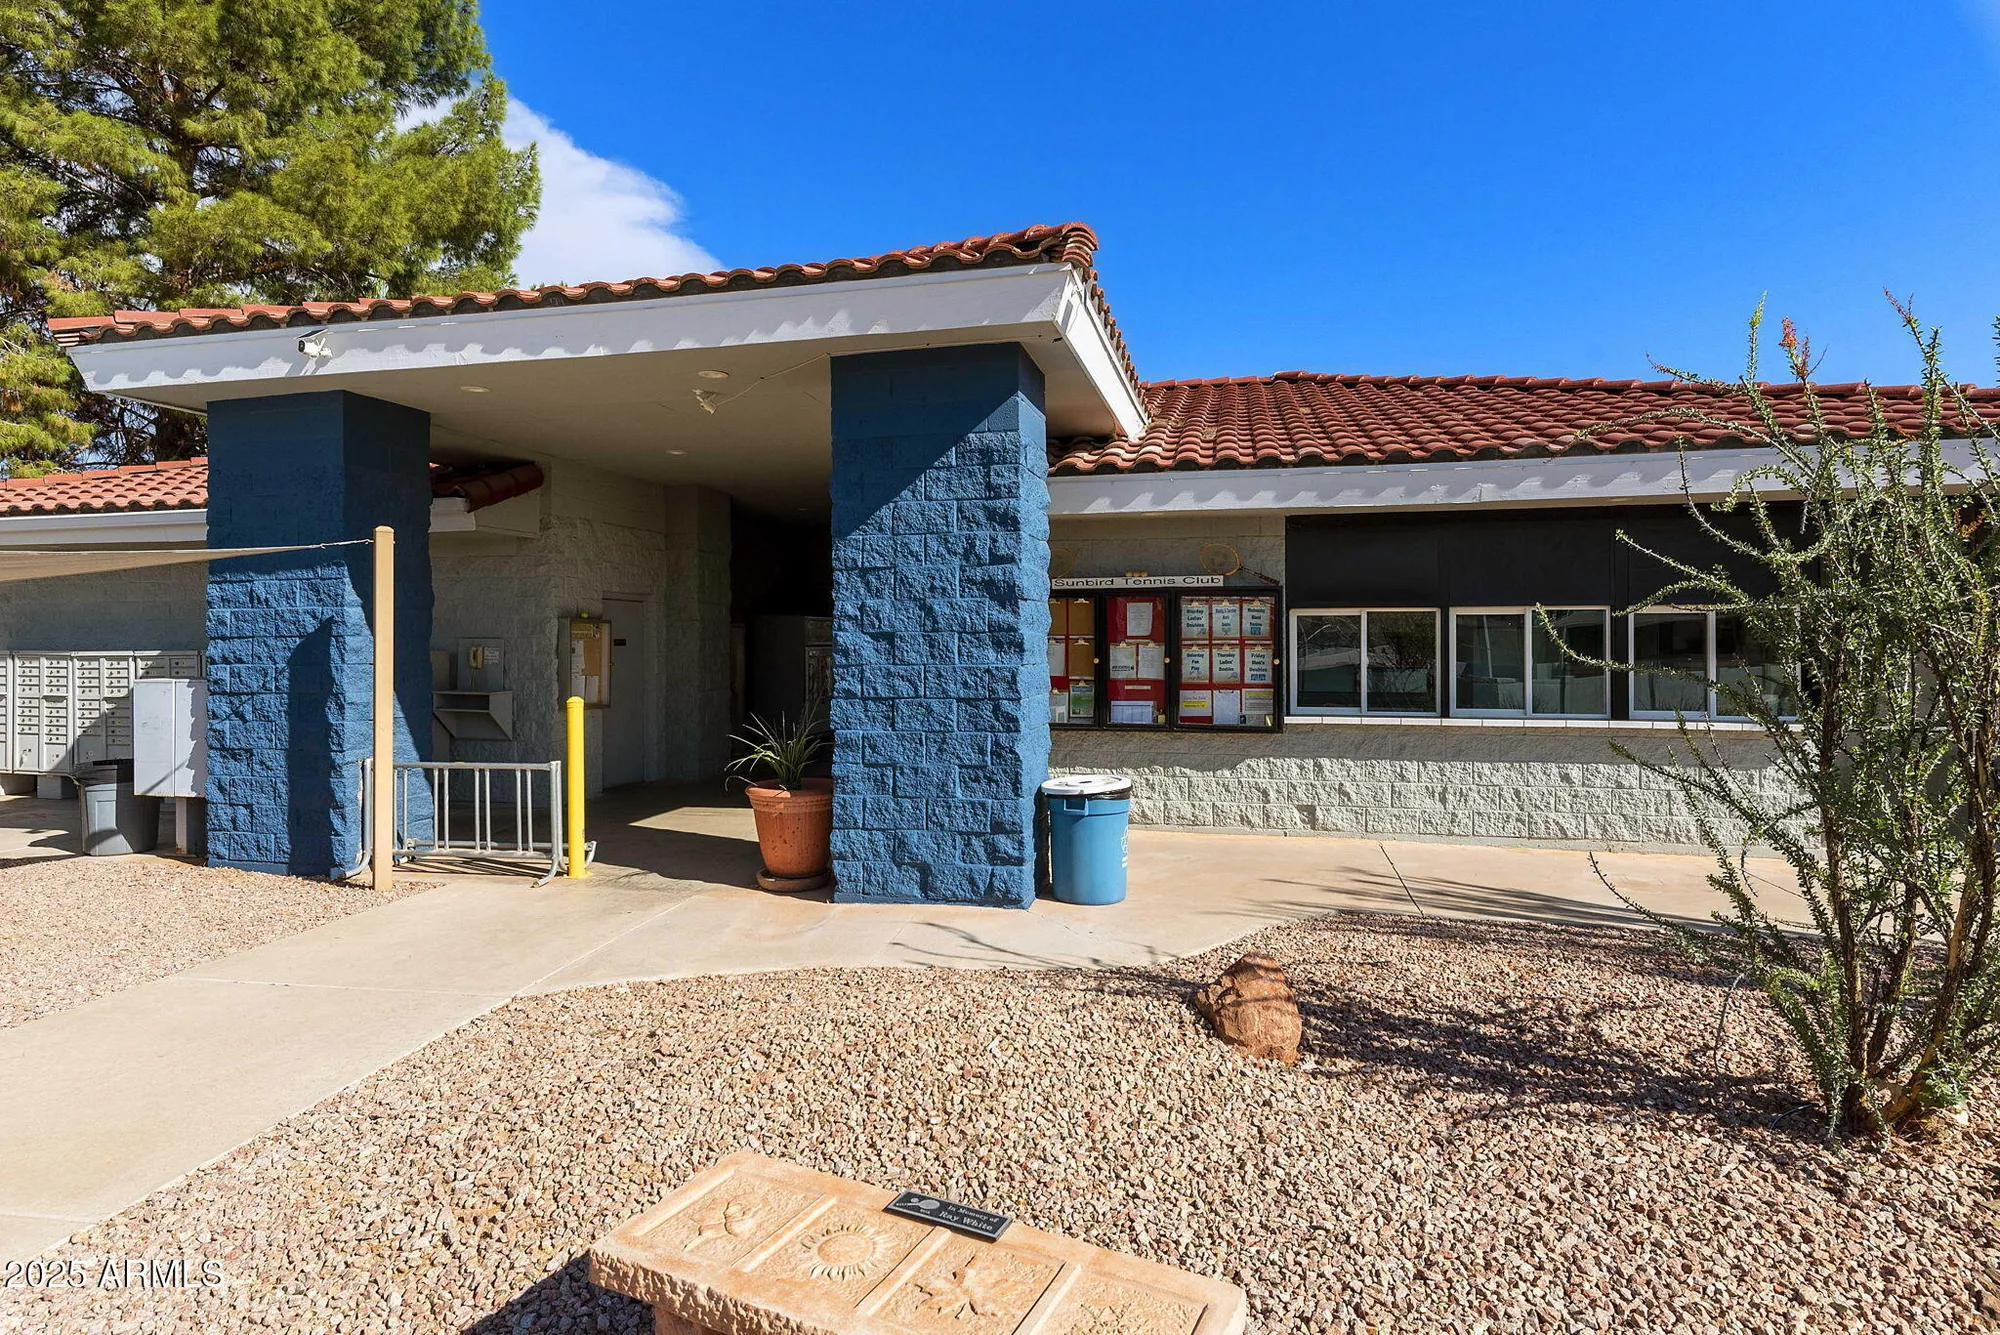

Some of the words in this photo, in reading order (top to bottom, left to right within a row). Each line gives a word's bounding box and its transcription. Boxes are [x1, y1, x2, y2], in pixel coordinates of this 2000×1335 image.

[1054, 578, 1114, 587] Sunbird
[1121, 577, 1176, 586] Tennis
[1182, 576, 1221, 585] Club
[957, 1208, 988, 1220] Memory
[939, 1211, 960, 1222] Ray
[962, 1216, 993, 1230] White
